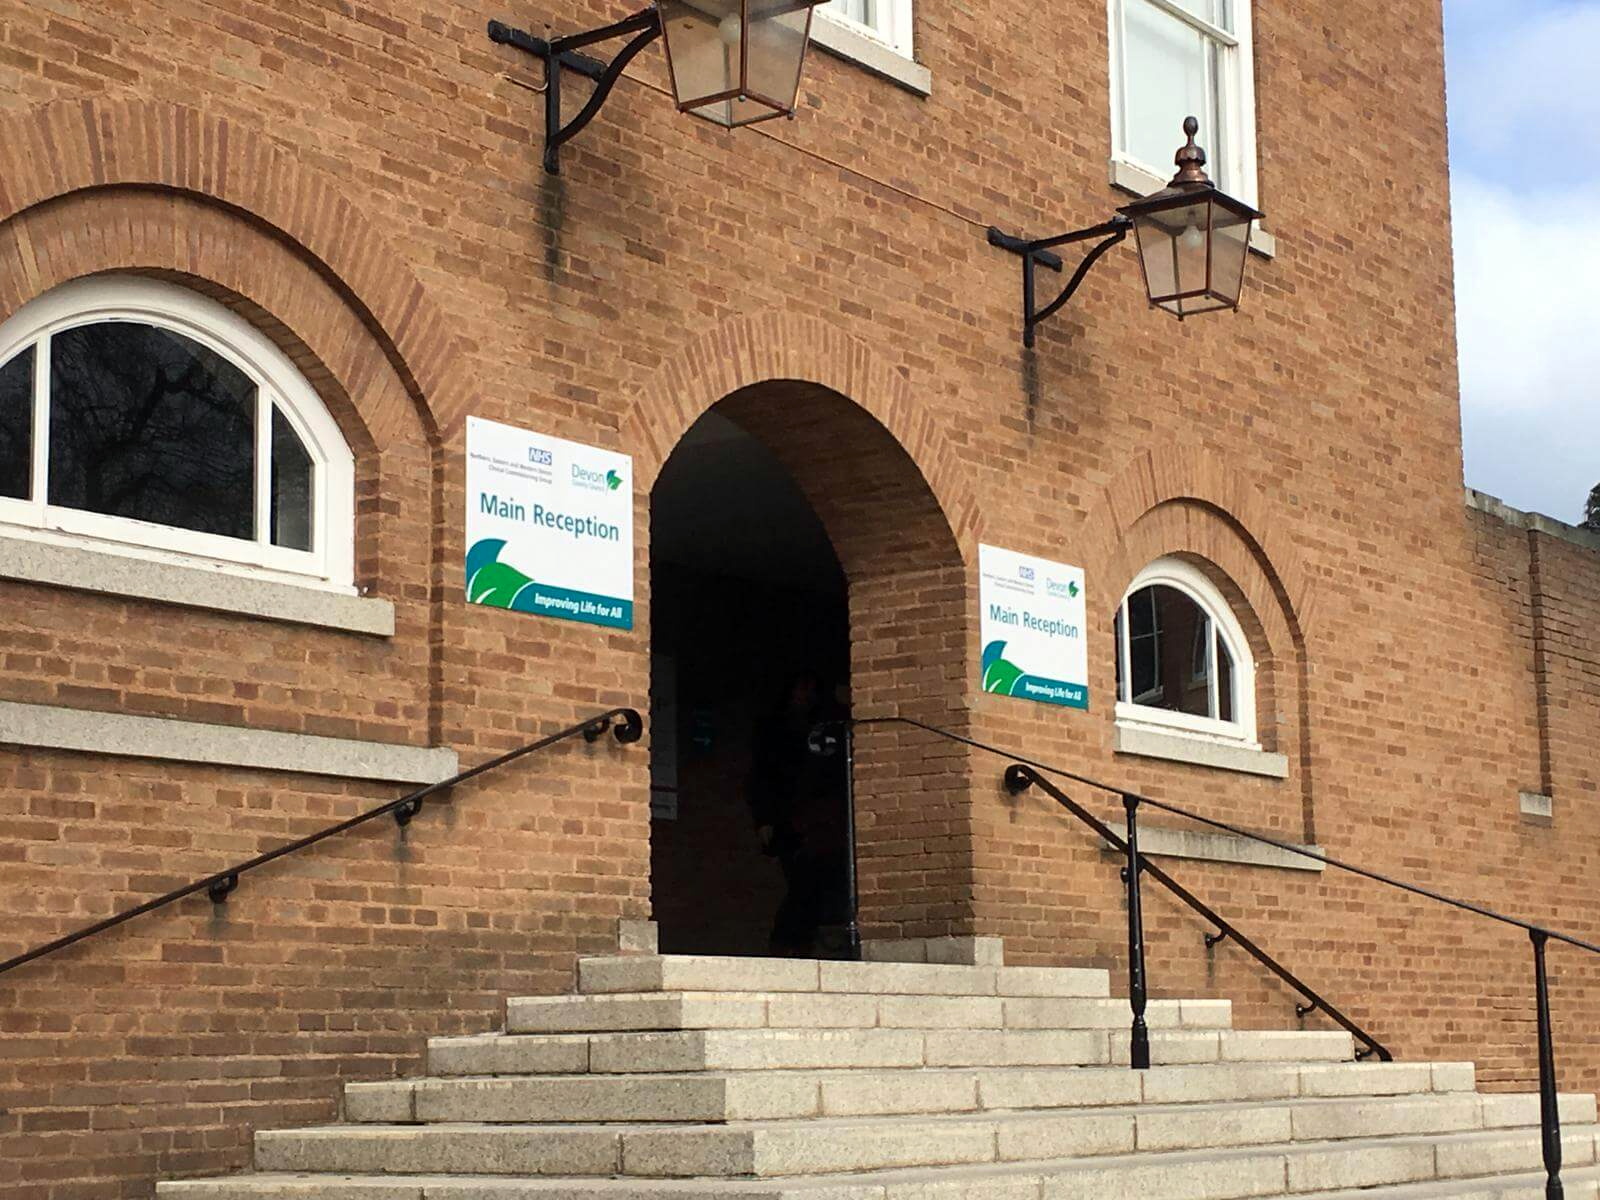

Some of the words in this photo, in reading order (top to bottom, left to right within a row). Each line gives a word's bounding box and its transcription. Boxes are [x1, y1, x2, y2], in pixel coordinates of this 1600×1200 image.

[529, 447, 552, 466] NHS
[571, 463, 605, 484] Devon
[480, 492, 525, 521] Main
[533, 503, 619, 541] Reception
[535, 592, 580, 614] Improving
[580, 600, 596, 615] Life
[596, 603, 610, 617] for
[610, 606, 623, 619] All
[990, 603, 1019, 626] Main
[1023, 611, 1079, 639] Reception
